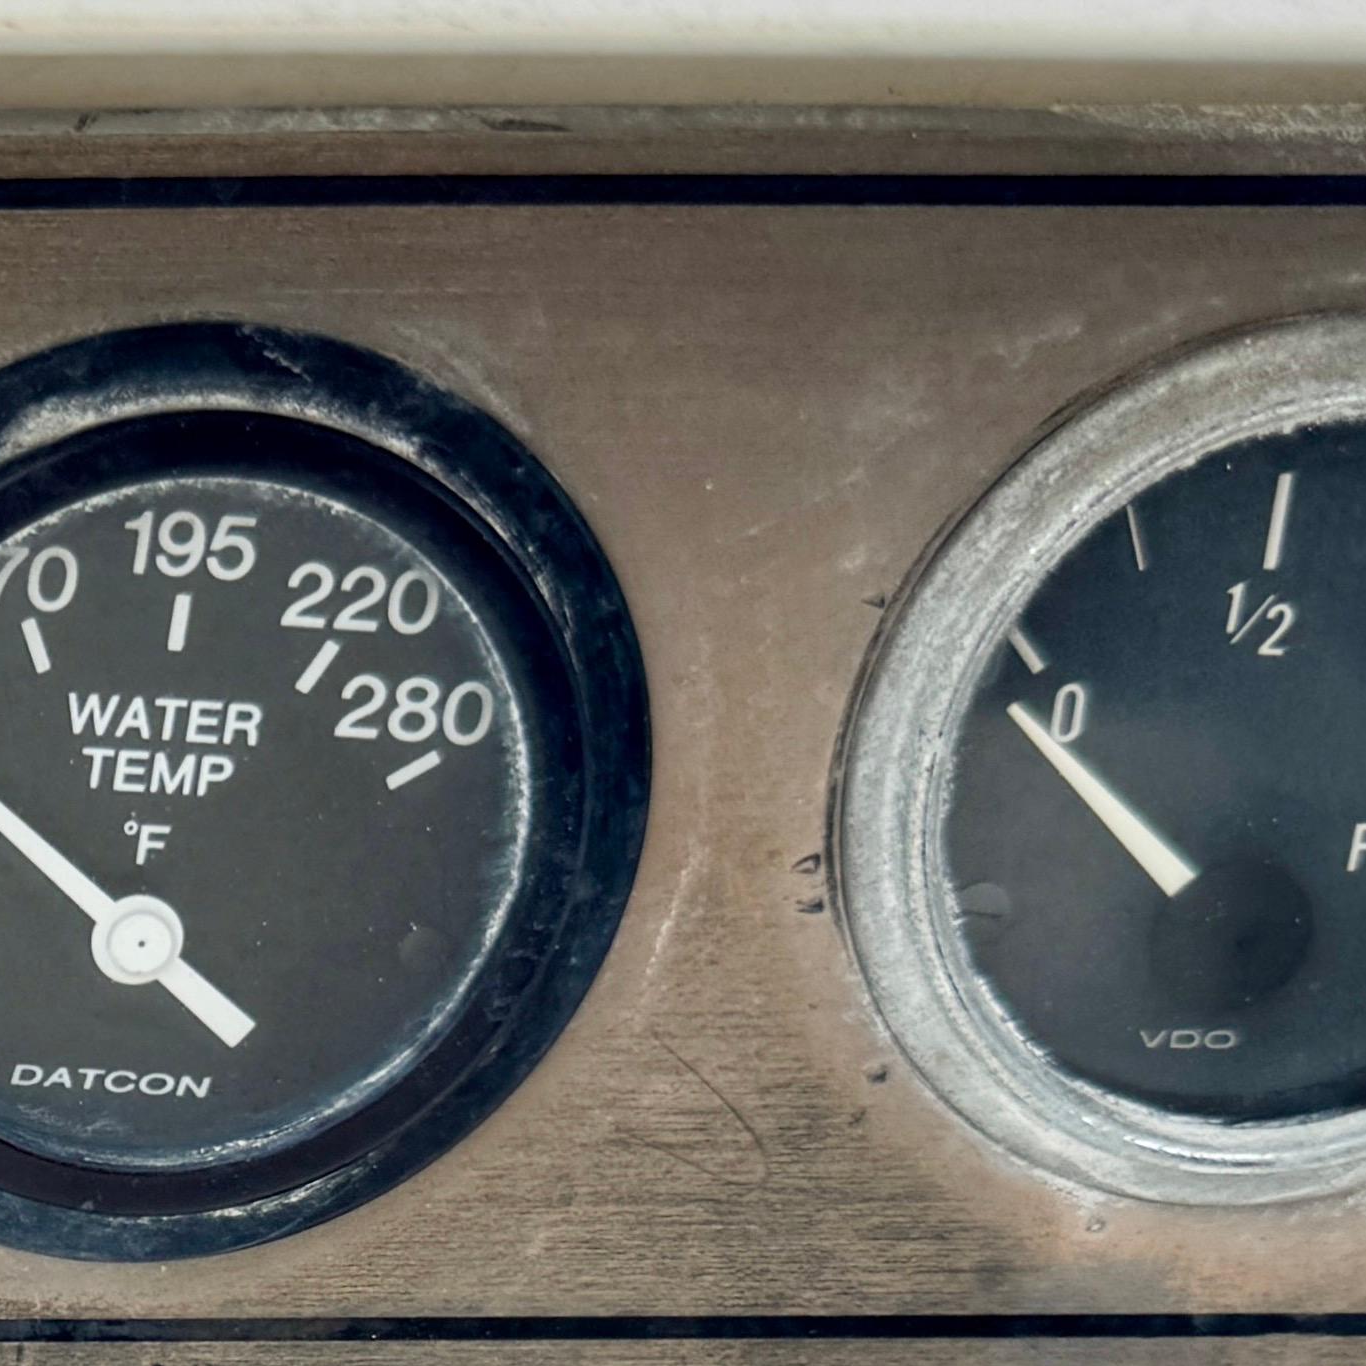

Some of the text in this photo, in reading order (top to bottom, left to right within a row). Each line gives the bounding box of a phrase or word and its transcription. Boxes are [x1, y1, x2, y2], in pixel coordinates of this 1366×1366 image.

[123, 510, 258, 580] 195
[280, 561, 439, 635] 220
[68, 692, 263, 746] WATER
[333, 673, 493, 746] 280
[1049, 682, 1085, 743] 0
[81, 746, 234, 797] TEMP
[1139, 1028, 1237, 1049] VDO
[10, 1062, 211, 1098] DATCON
